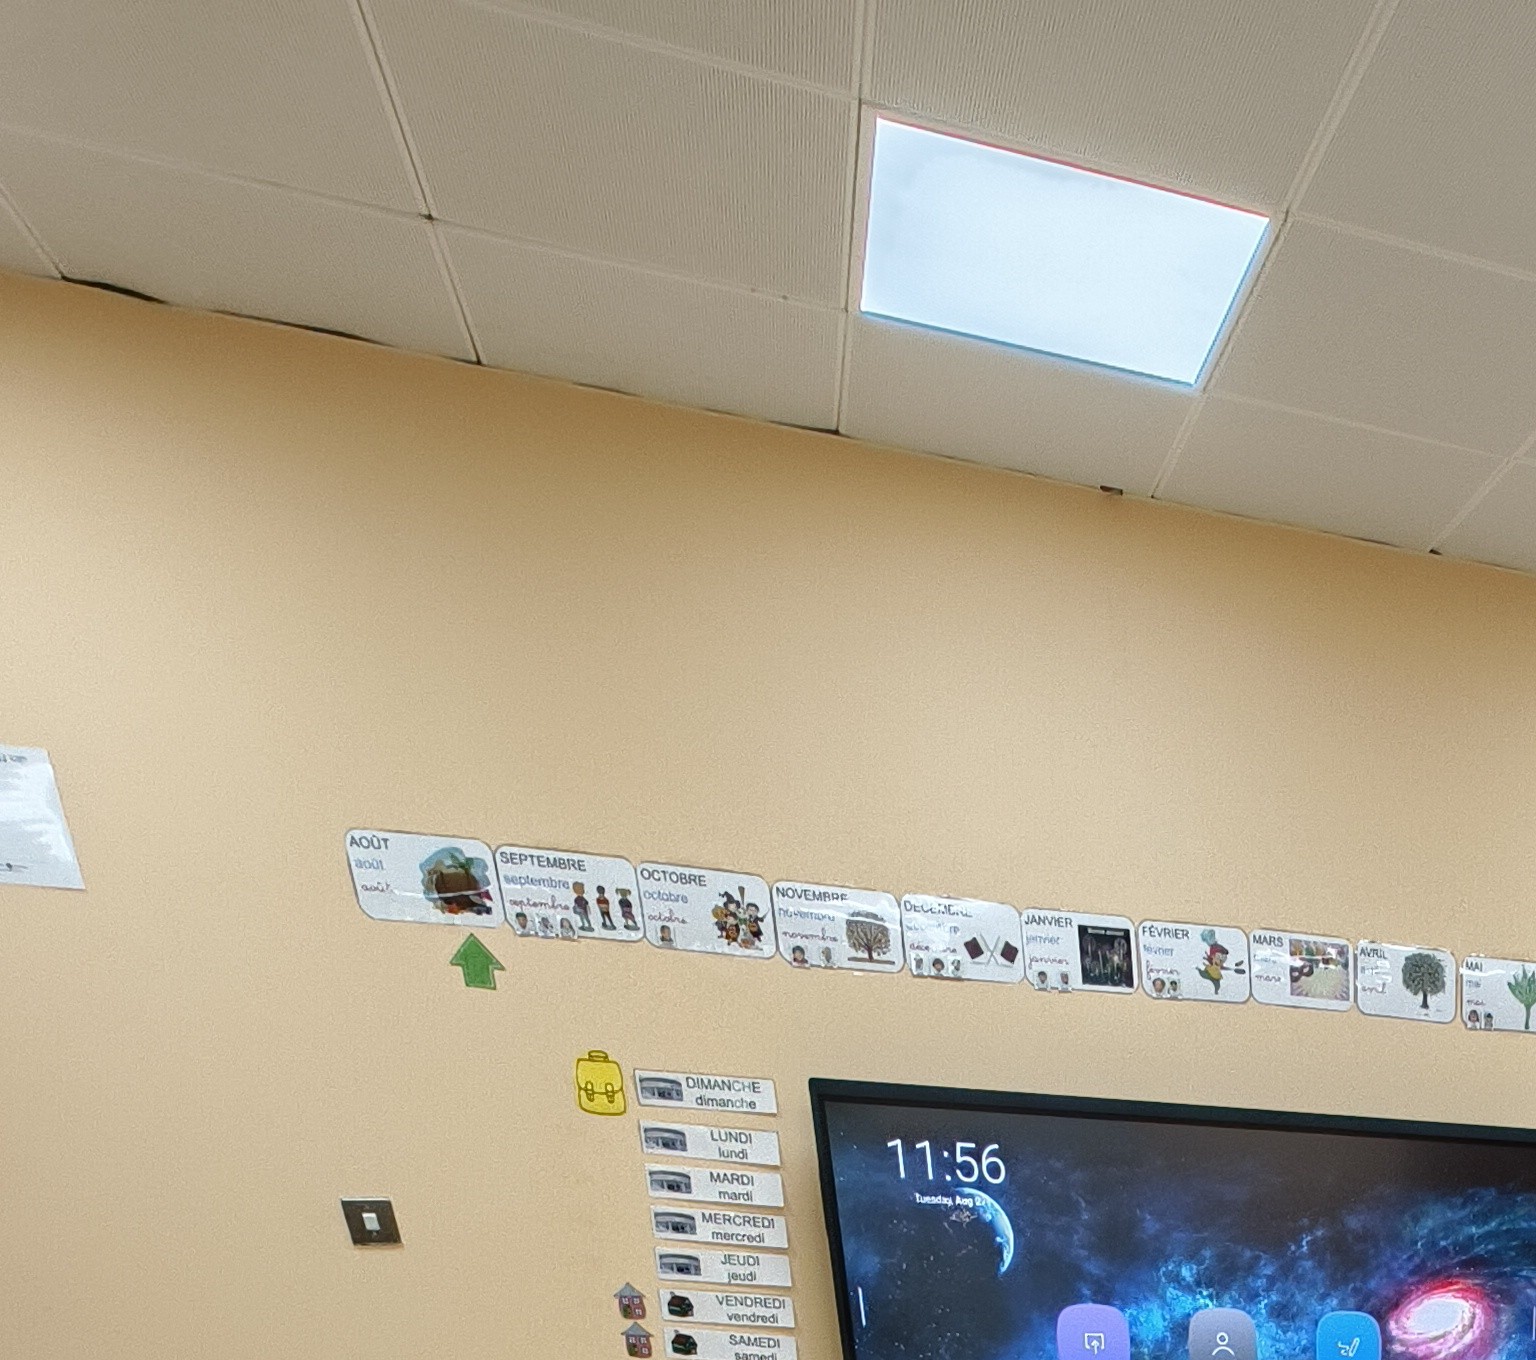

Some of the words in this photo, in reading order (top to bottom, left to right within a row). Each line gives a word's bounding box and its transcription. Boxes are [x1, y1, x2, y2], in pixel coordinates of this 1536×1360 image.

[349, 835, 390, 851] AOÛT
[500, 851, 586, 872] SEPTEMBRE
[503, 873, 570, 890] septembre
[640, 869, 707, 886] OCTOBRE
[643, 889, 688, 904] octobre
[775, 886, 848, 902] NOVEMBRE
[1024, 914, 1073, 927] JANVIER
[1142, 924, 1190, 939] FÉVRIER
[1253, 934, 1284, 948] MARS
[1360, 946, 1387, 959] AVRIL
[1466, 961, 1482, 972] MAI
[686, 1076, 761, 1093] DIMANCHE
[695, 1095, 756, 1110] dimanche
[711, 1130, 752, 1144] LUNDI
[718, 1147, 748, 1160] lundi
[887, 1138, 1006, 1185] 11:56
[709, 1172, 754, 1187] MARDI
[718, 1189, 753, 1202] mardi
[702, 1212, 775, 1229] MERCREDI
[712, 1230, 764, 1243] mercredi
[720, 1254, 759, 1267] JEUDI
[728, 1270, 756, 1283] jeudi
[716, 1295, 786, 1310] VENDREDI
[727, 1311, 778, 1324] vendredi
[729, 1335, 780, 1349] SAMEDI
